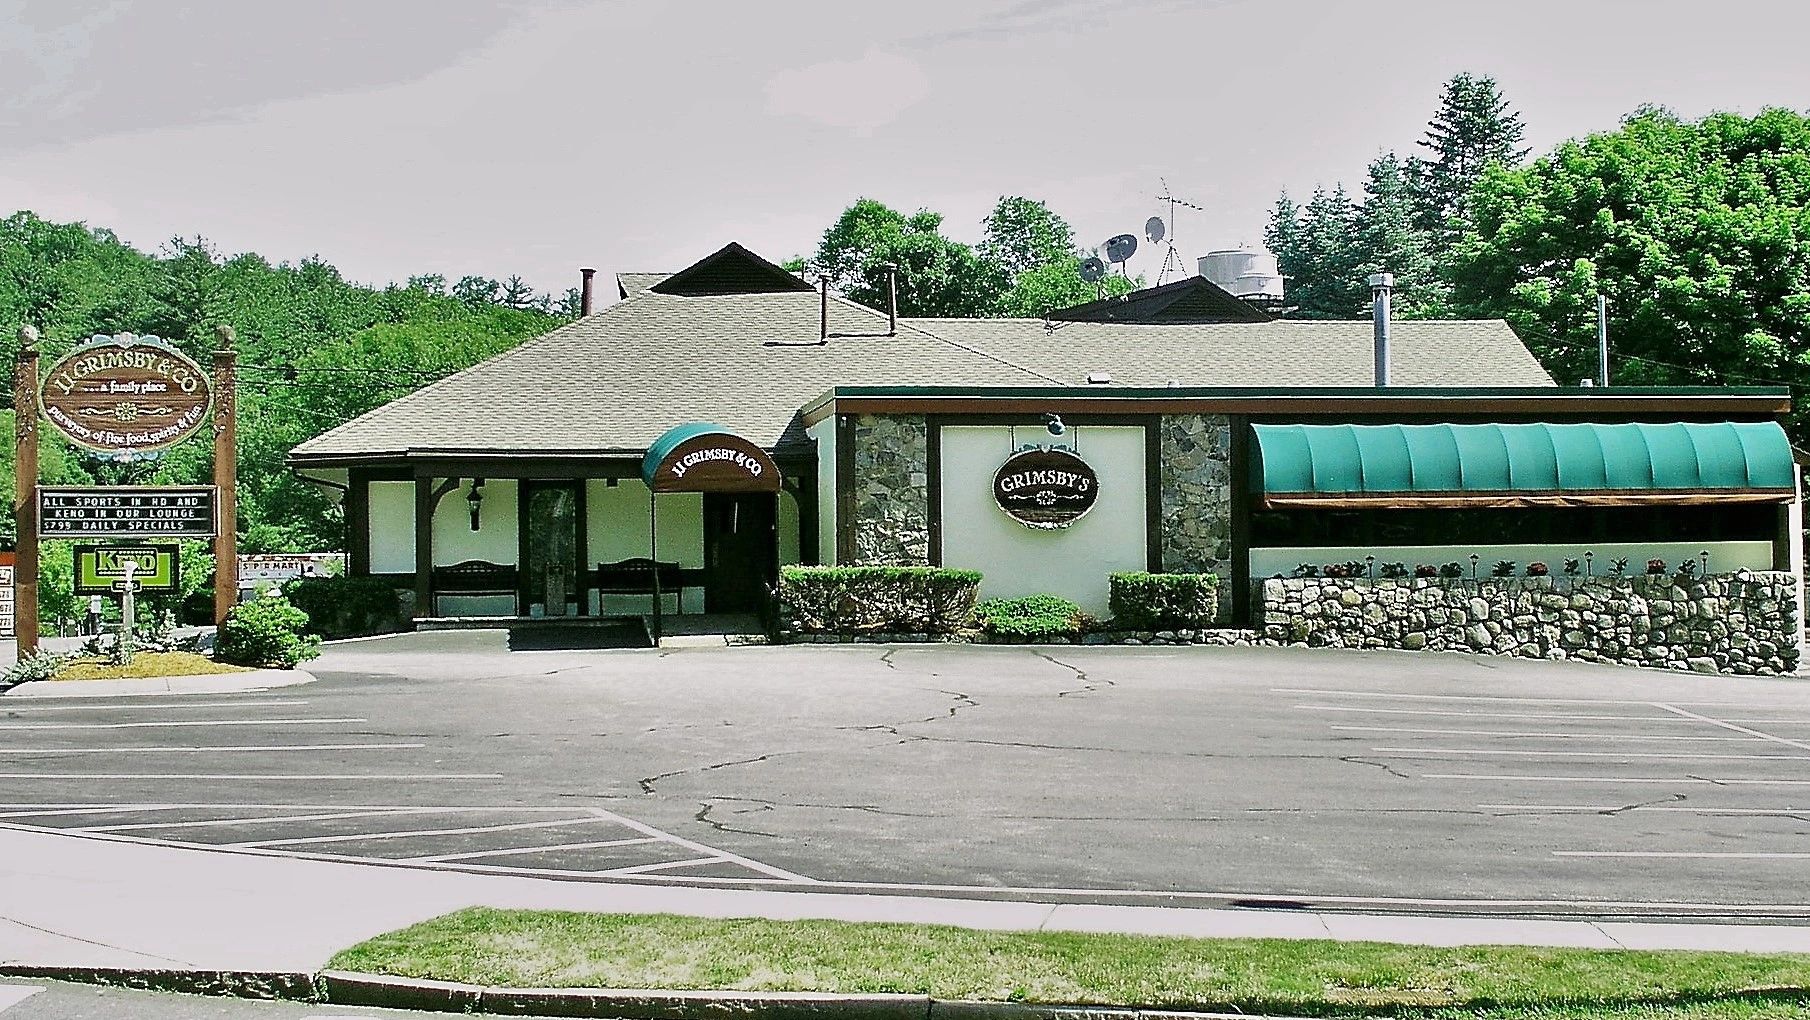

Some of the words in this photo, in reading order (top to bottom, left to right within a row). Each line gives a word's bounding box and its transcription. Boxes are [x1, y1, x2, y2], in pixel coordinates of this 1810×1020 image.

[73, 351, 158, 378] GRIMSBY
[158, 358, 175, 377] &
[110, 380, 141, 394] family
[141, 381, 167, 394] place
[92, 431, 106, 444] of
[106, 431, 125, 444] fine
[185, 404, 203, 424] fun
[683, 448, 737, 467] GRIMSBY
[735, 453, 748, 467] &
[1000, 469, 1090, 492] GRIMSBY'S
[43, 497, 66, 507] ALL
[75, 497, 121, 507] SPORTS
[131, 497, 141, 507] IN
[152, 497, 167, 507] HD
[177, 497, 199, 507] AND
[55, 509, 85, 518] KENO
[95, 509, 107, 518] IN
[116, 509, 140, 518] OUR
[149, 509, 195, 518] LOUNGE
[82, 521, 118, 530] DAILY
[128, 521, 184, 530] SPECIALS
